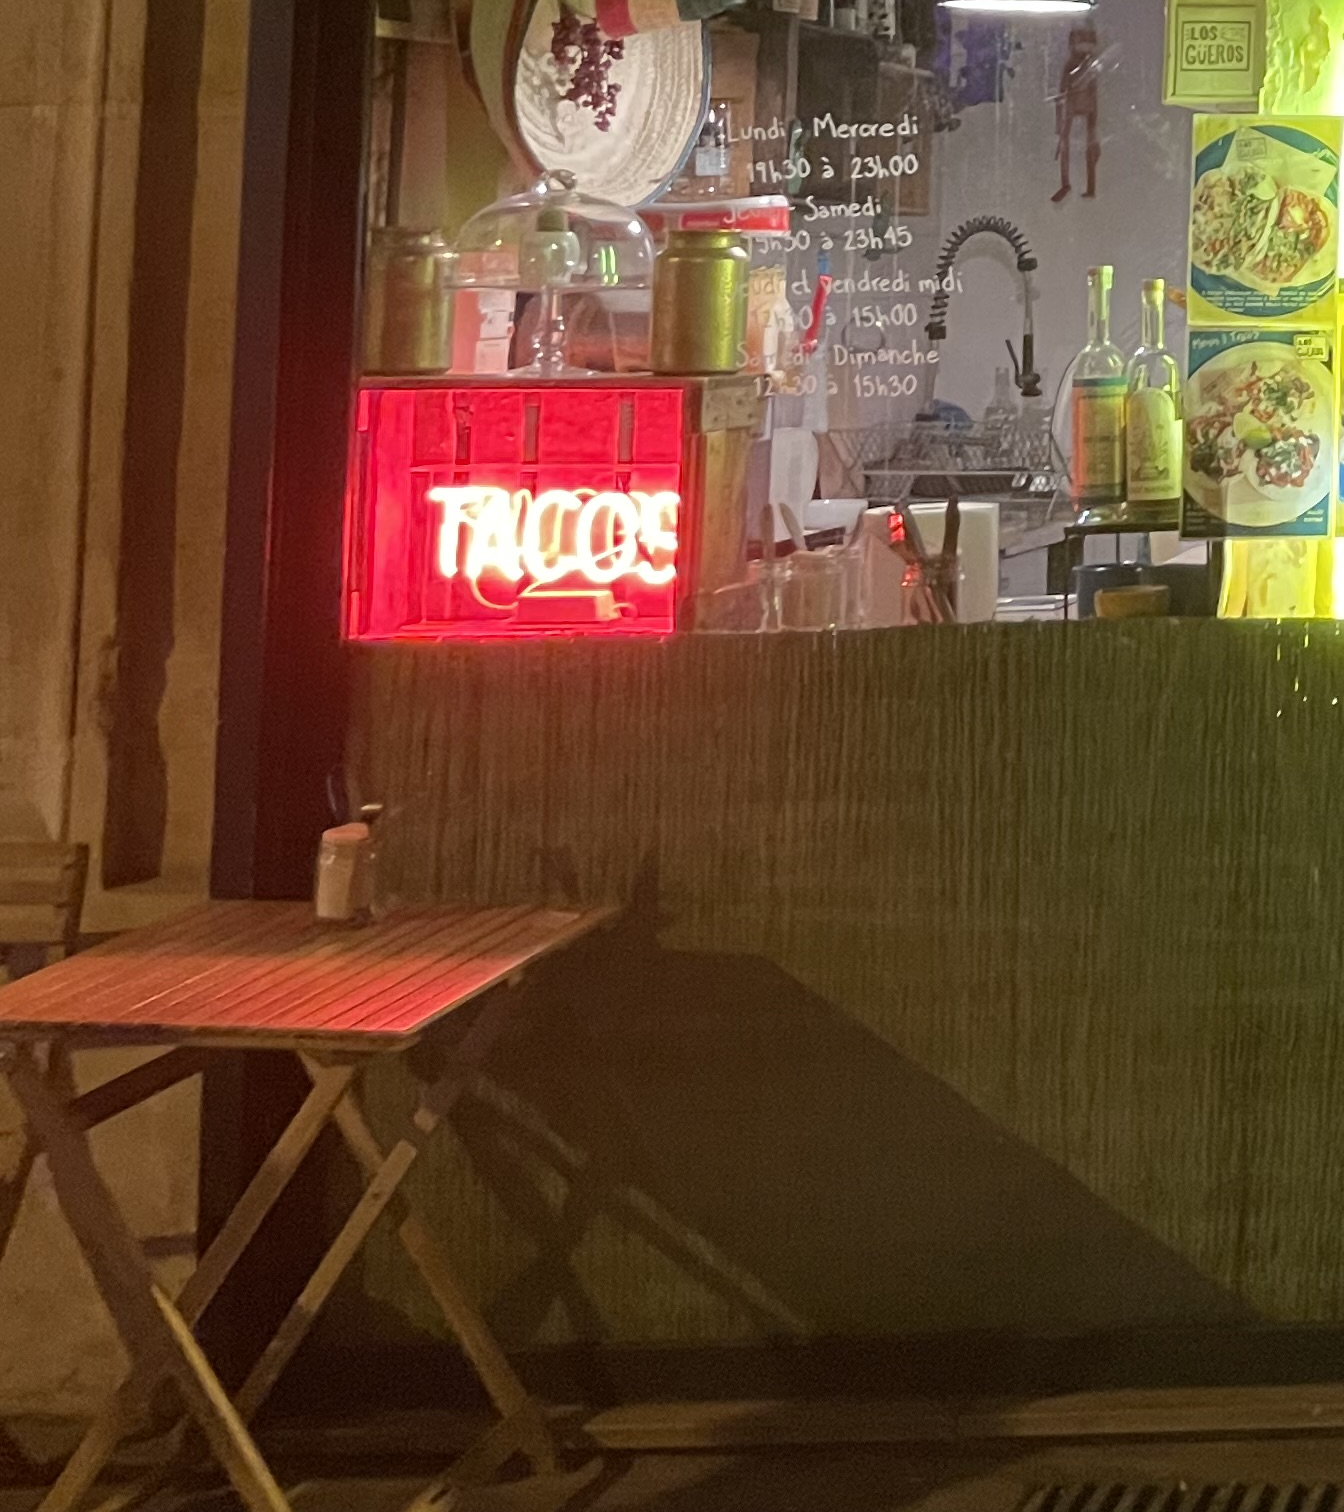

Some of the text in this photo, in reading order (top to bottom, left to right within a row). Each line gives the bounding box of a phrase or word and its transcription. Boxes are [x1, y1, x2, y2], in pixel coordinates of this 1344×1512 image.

[1190, 25, 1217, 41] LOS
[727, 116, 786, 144] Lundi
[813, 112, 919, 139] Mercredi
[748, 153, 919, 184] 19h30 à 23h00
[803, 195, 882, 222] Samedi
[820, 231, 834, 250] à
[843, 225, 913, 251] 23h45
[821, 269, 911, 294] vendredi
[918, 270, 963, 294] midi
[852, 303, 917, 328] 15h00
[833, 339, 940, 368] Dimanche
[853, 374, 918, 398] 15h30
[427, 486, 681, 585] TACOS
